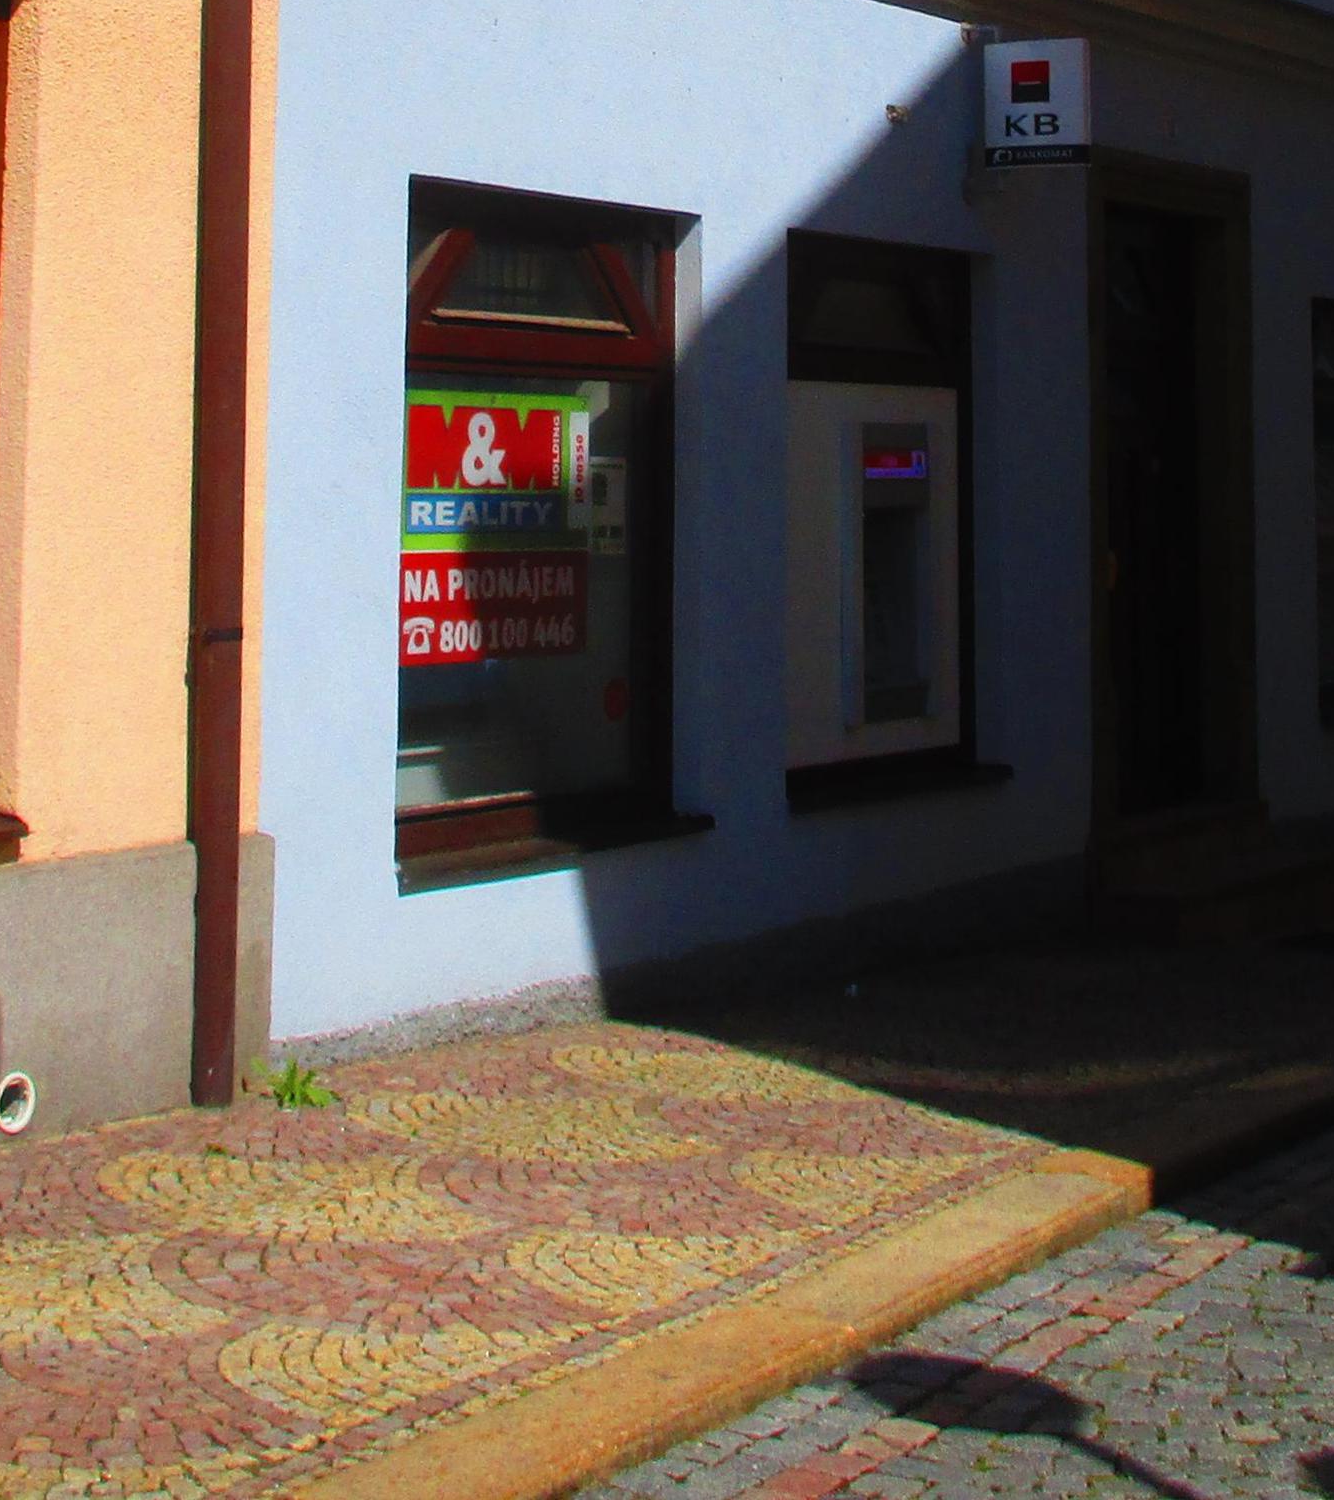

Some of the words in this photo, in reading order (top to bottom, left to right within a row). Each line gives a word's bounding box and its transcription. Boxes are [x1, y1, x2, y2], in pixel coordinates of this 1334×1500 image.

[1005, 113, 1061, 137] KB
[551, 415, 562, 486] HOLDING
[410, 501, 553, 526] REALITY
[404, 569, 440, 604] NA
[447, 560, 575, 604] PRONÁJEM
[439, 621, 483, 652] 800
[487, 617, 528, 649] 100
[533, 613, 576, 648] 446
